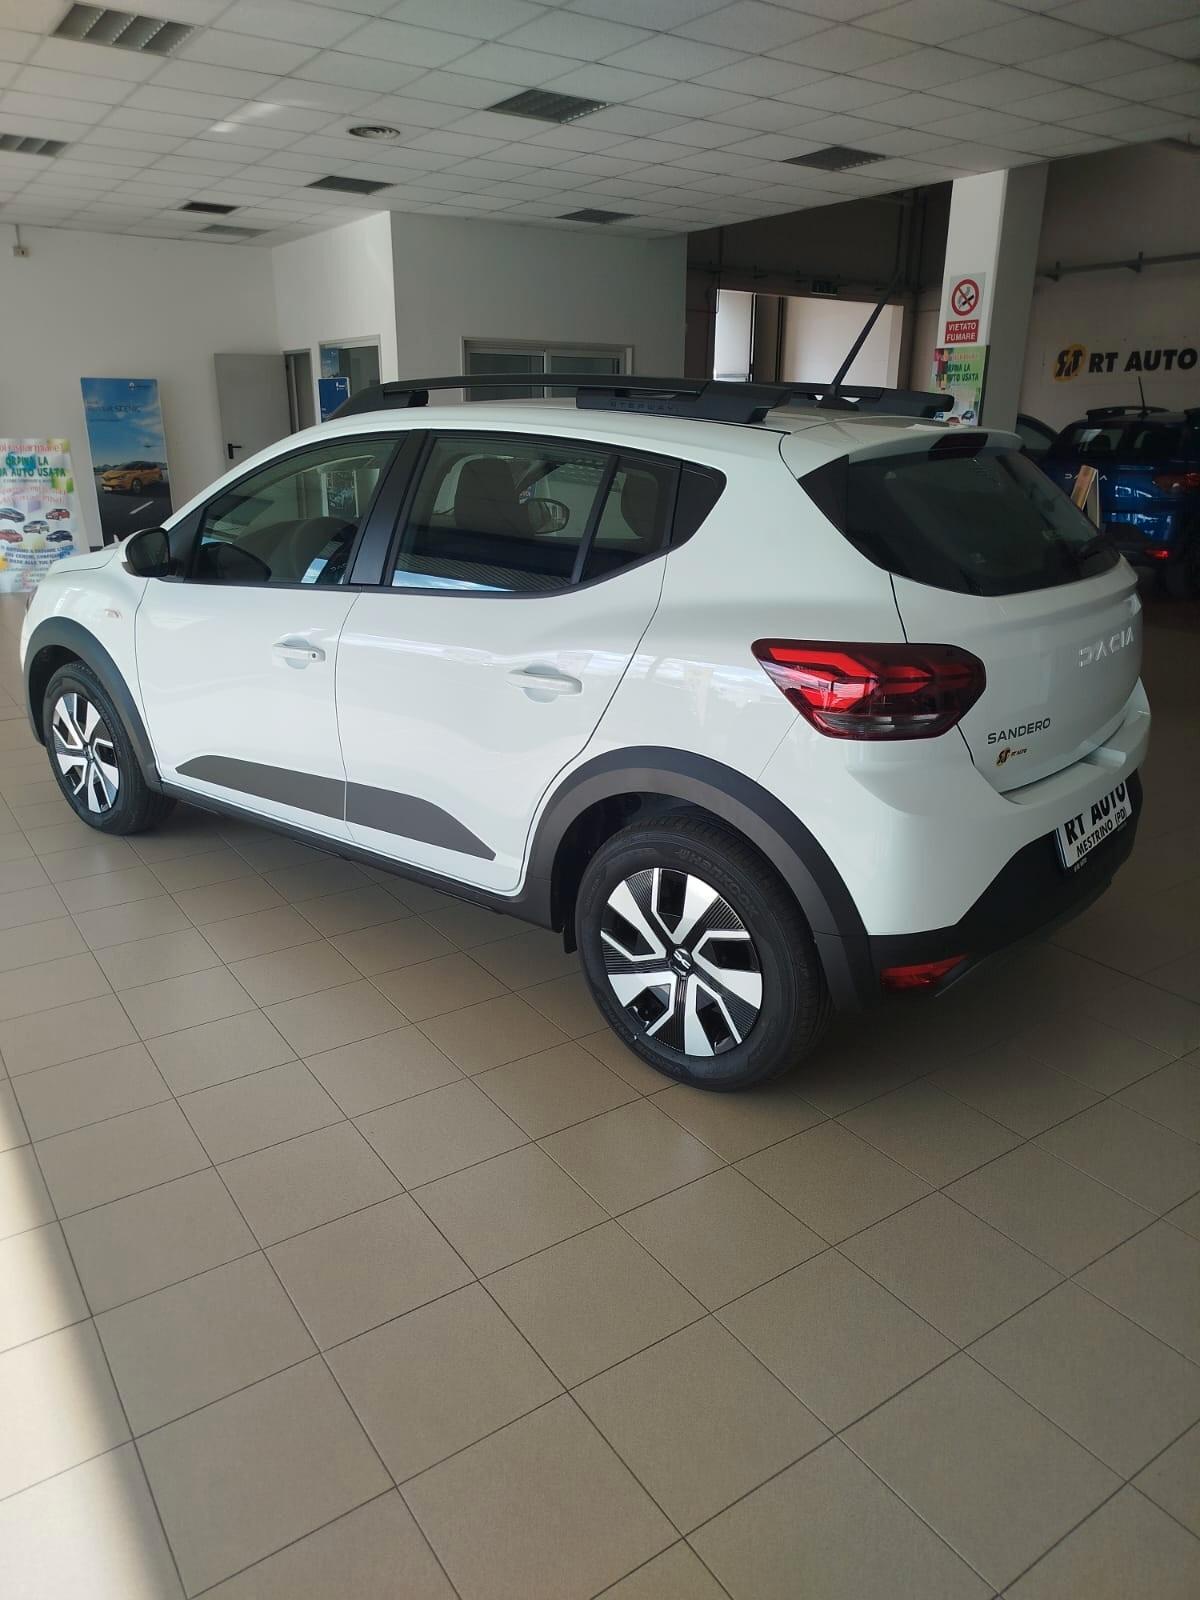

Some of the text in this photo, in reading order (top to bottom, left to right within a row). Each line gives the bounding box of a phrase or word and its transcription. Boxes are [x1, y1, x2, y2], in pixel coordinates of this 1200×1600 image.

[946, 332, 976, 342] FUMARE
[948, 322, 977, 332] VIETATO
[1088, 352, 1118, 373] RT
[1123, 347, 1198, 372] AUTO
[37, 467, 66, 478] USATA
[1079, 626, 1135, 668] DACIA
[987, 717, 1051, 745] SANDERO
[1064, 781, 1126, 846] RT AUTO
[1076, 806, 1127, 858] MESTRINO (PD)
